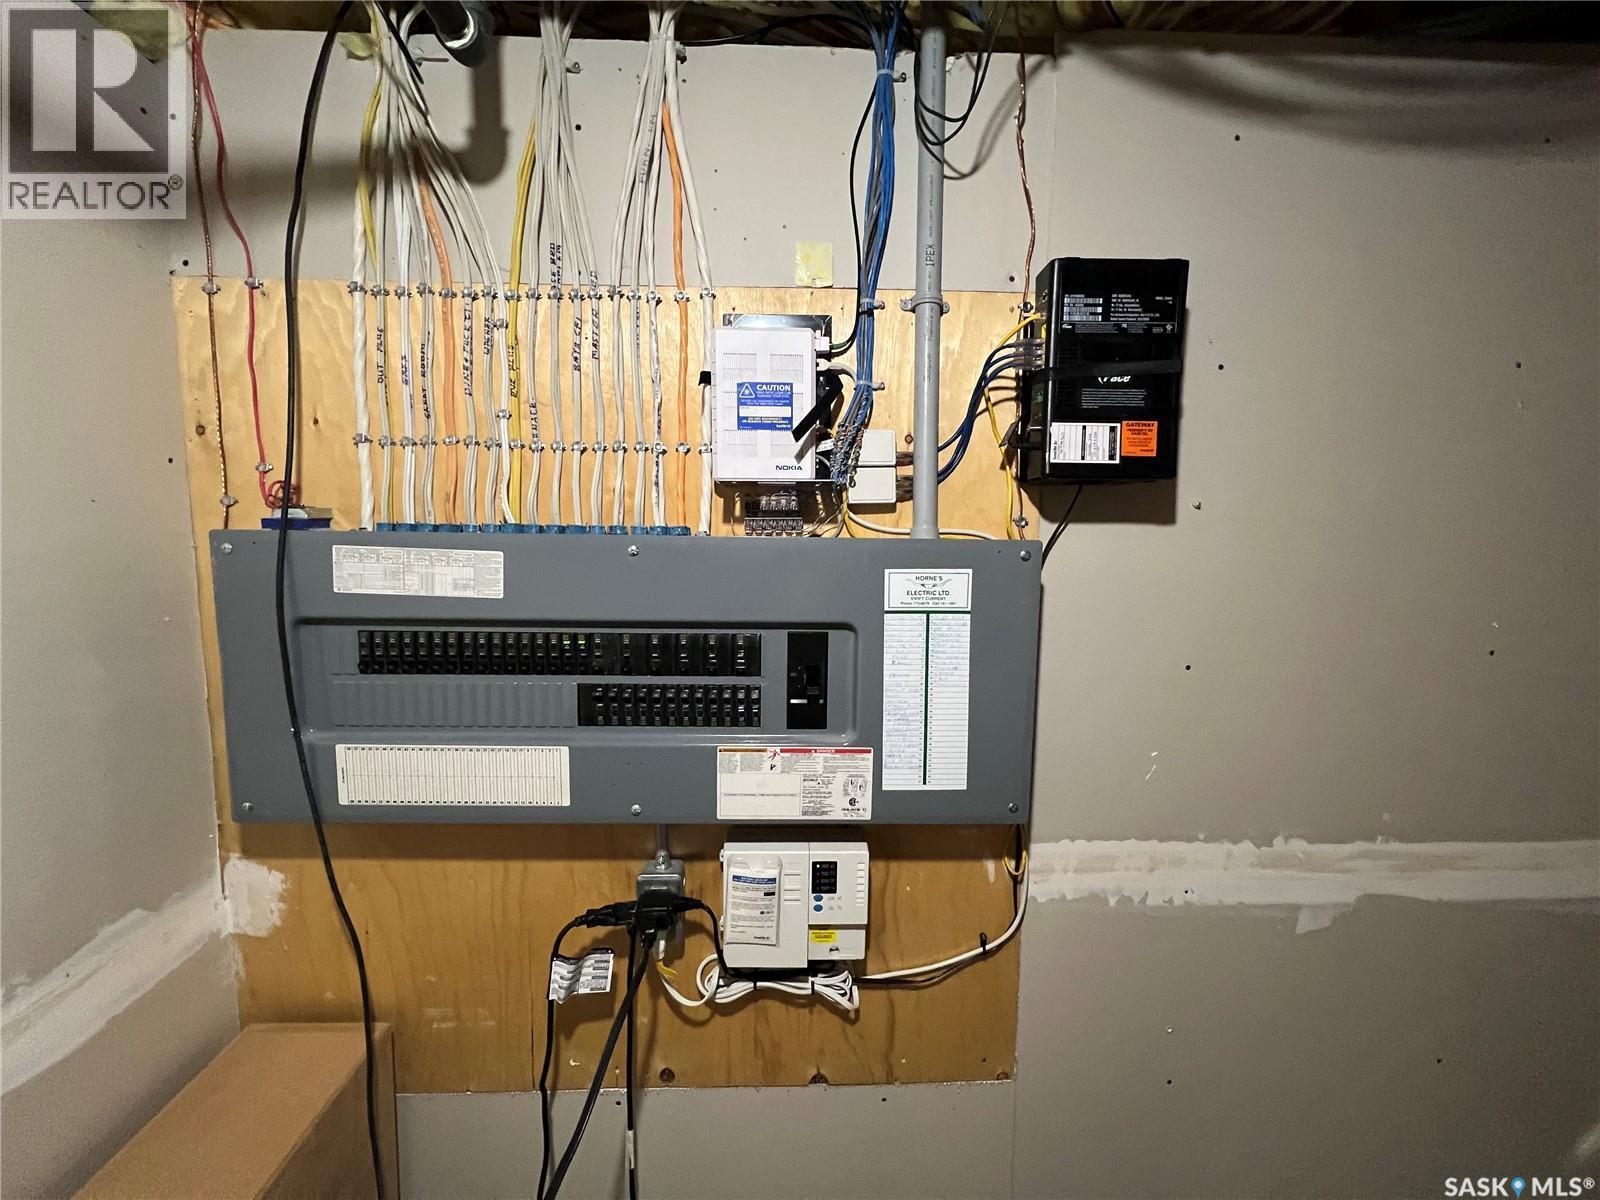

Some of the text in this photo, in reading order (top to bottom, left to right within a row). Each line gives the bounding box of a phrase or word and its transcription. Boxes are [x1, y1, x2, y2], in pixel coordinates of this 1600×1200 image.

[925, 244, 935, 267] IPEX
[376, 361, 384, 384] OUT
[756, 384, 791, 392] CAUTION
